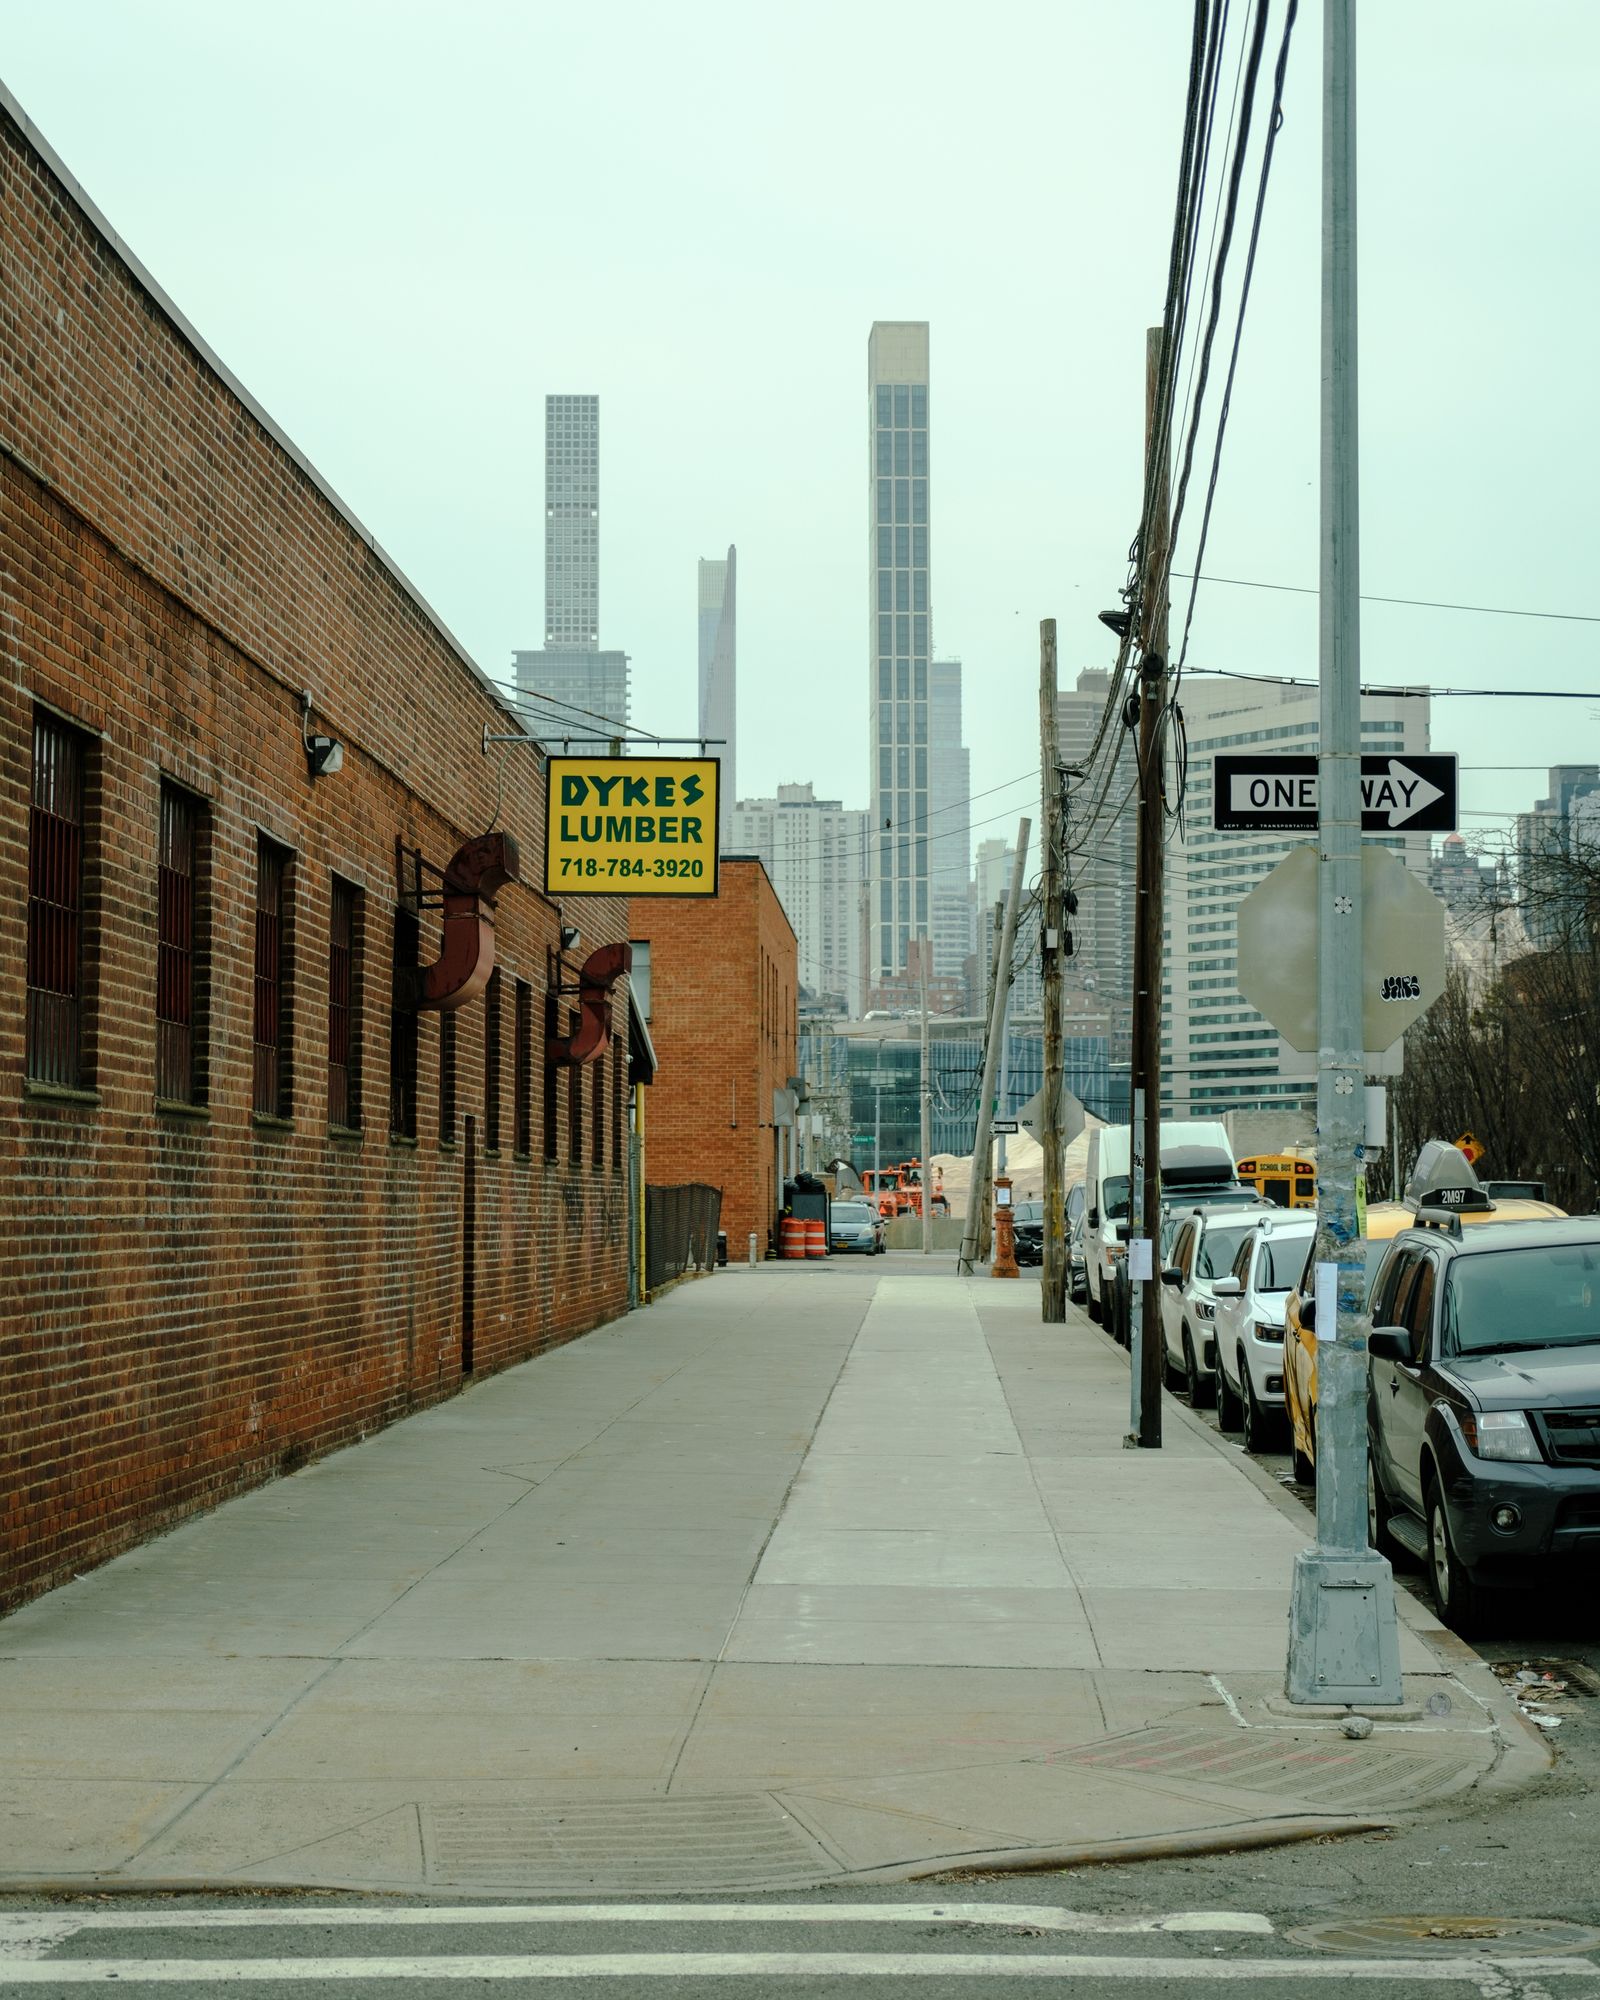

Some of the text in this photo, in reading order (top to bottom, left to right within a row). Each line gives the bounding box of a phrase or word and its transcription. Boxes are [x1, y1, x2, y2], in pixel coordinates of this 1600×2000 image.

[561, 774, 704, 807] DYKES
[1250, 779, 1316, 807] ONE
[561, 815, 703, 844] LUMBER
[560, 858, 703, 877] 718-784-3920
[1441, 1190, 1466, 1204] 2M97
